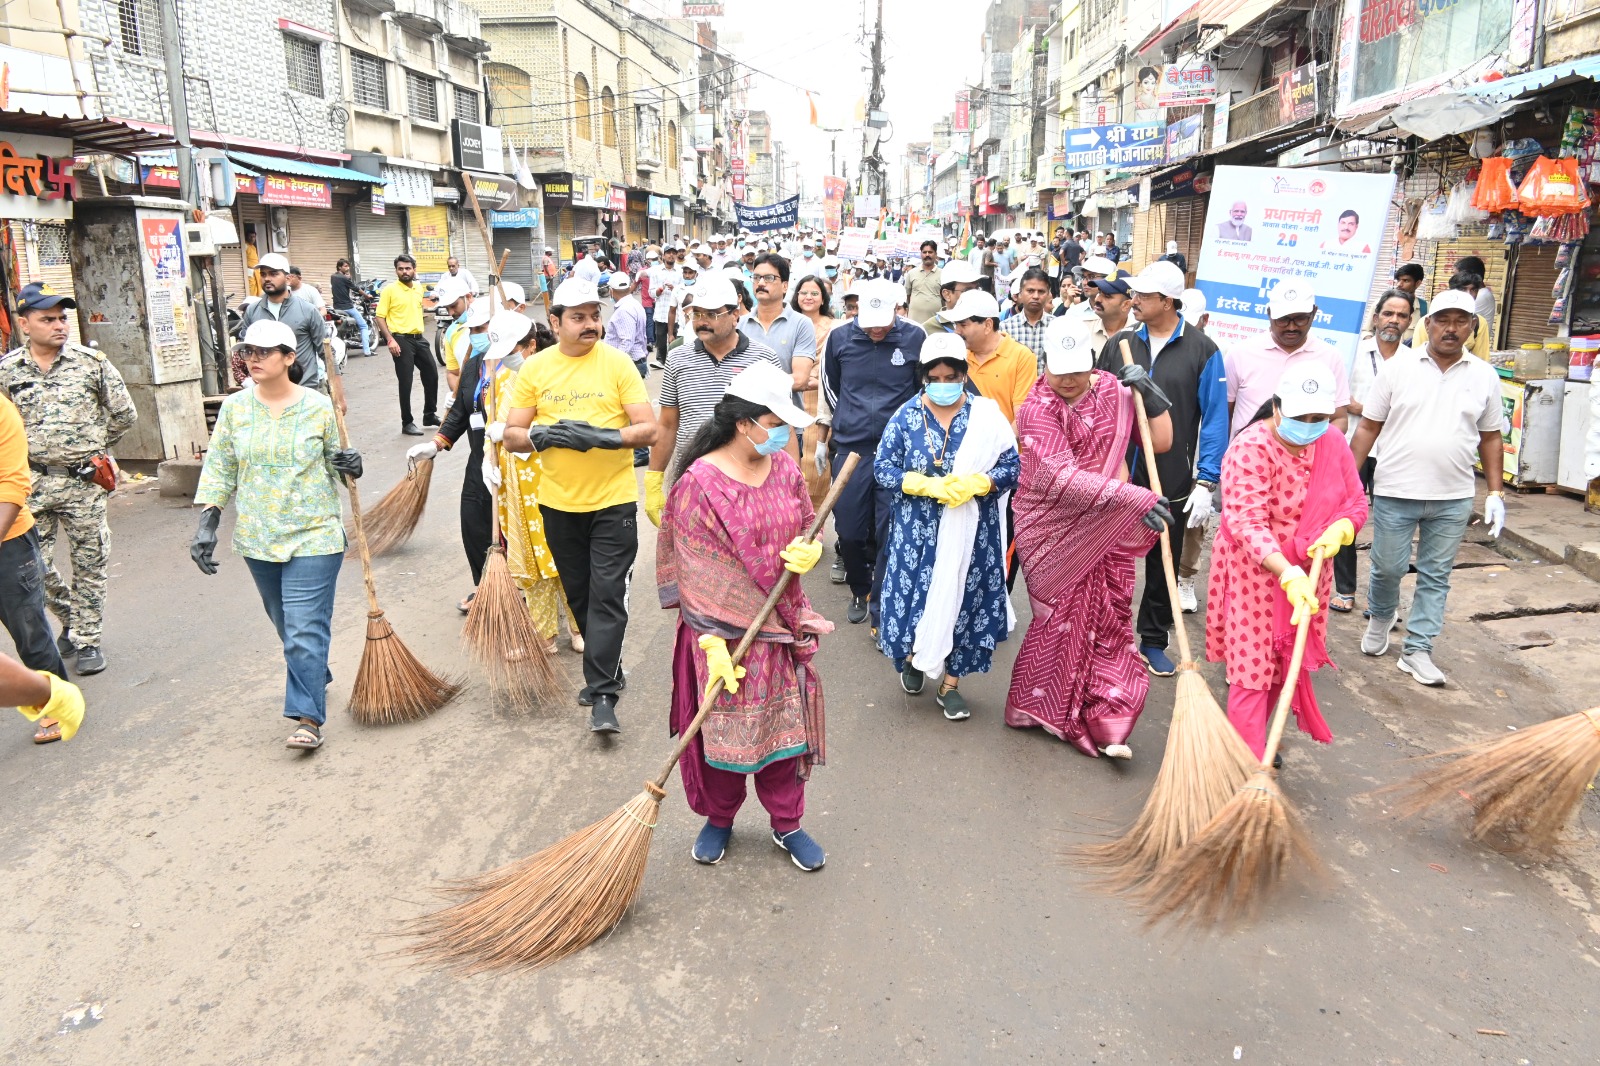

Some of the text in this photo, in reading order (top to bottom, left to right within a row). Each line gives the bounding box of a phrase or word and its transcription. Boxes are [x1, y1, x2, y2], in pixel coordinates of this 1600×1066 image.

[1106, 126, 1126, 142] श्री
[1131, 126, 1159, 140] राम
[463, 137, 481, 149] JOCKEY
[267, 174, 286, 190] नेहा
[545, 184, 569, 193] MEHAK
[1264, 208, 1322, 225] प्रधानमंत्री
[1276, 233, 1298, 248] 2.0
[1217, 296, 1251, 312] इंटरेस्ट
